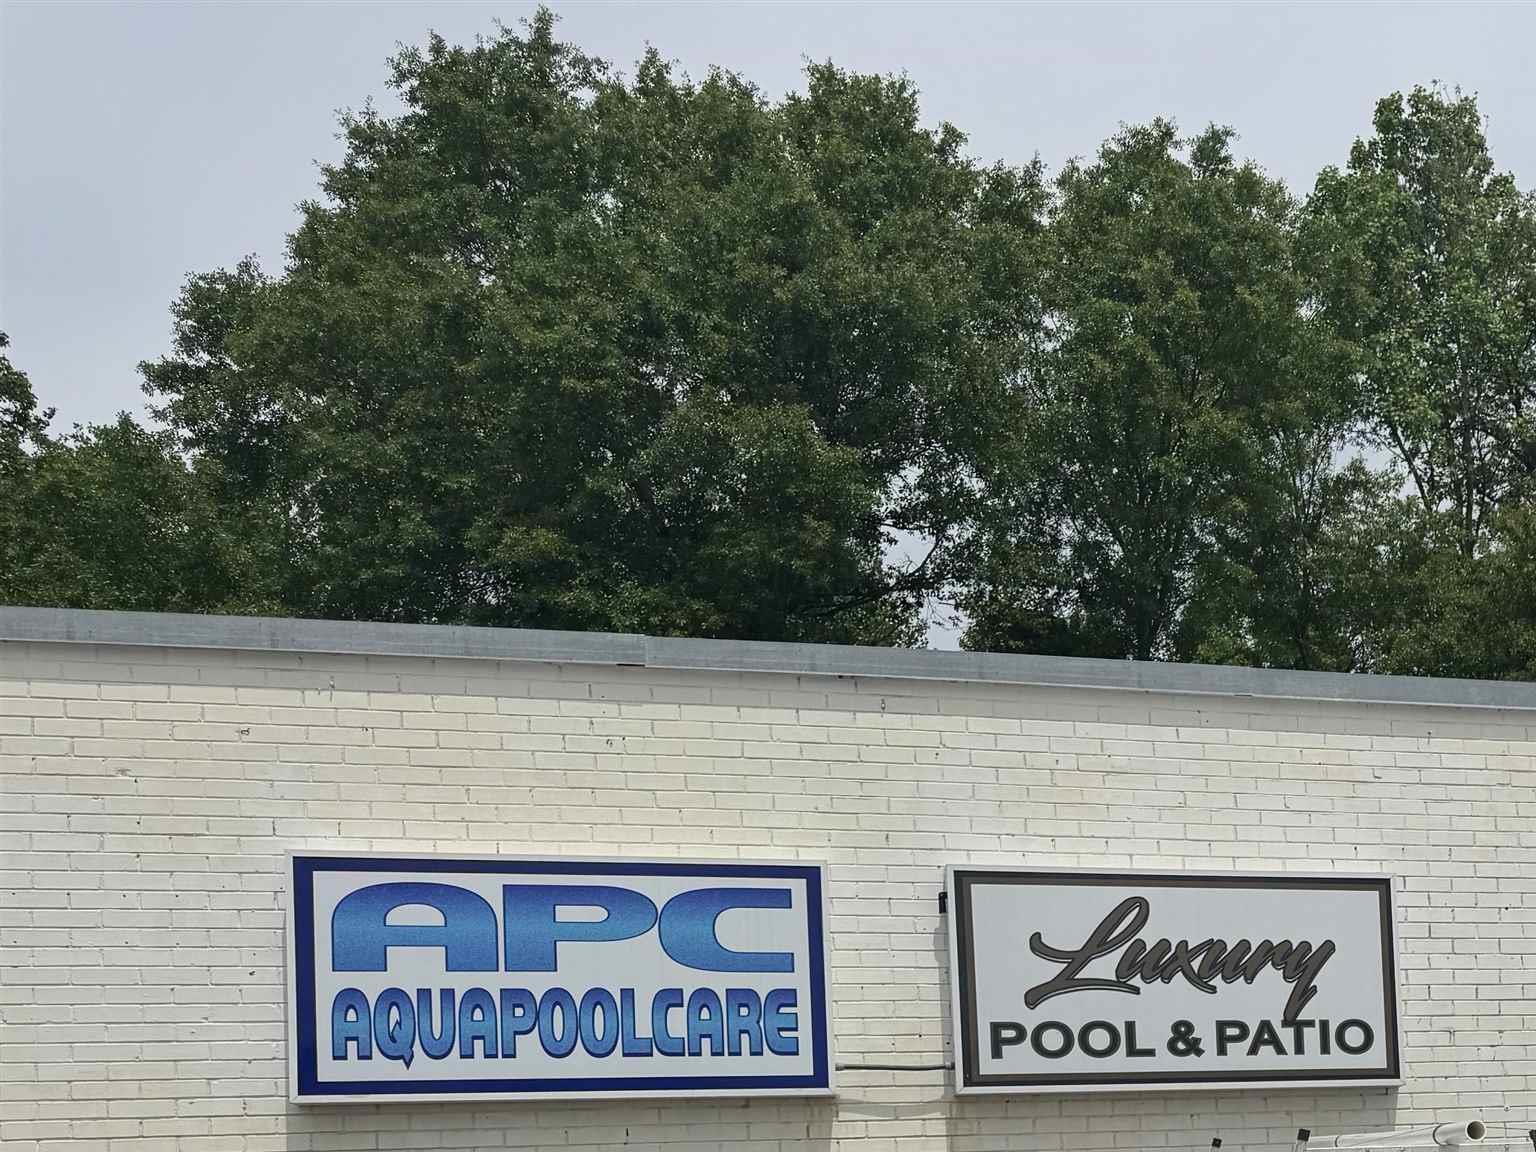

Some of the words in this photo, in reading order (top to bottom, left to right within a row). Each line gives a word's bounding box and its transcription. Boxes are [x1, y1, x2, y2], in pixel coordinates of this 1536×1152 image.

[332, 881, 795, 973] APC
[1023, 896, 1336, 1023] Luxury
[332, 987, 800, 1070] AQUAPOOLCARE
[990, 1020, 1157, 1060] POOL
[1166, 1020, 1205, 1057] &
[1215, 1018, 1375, 1057] PATIO
